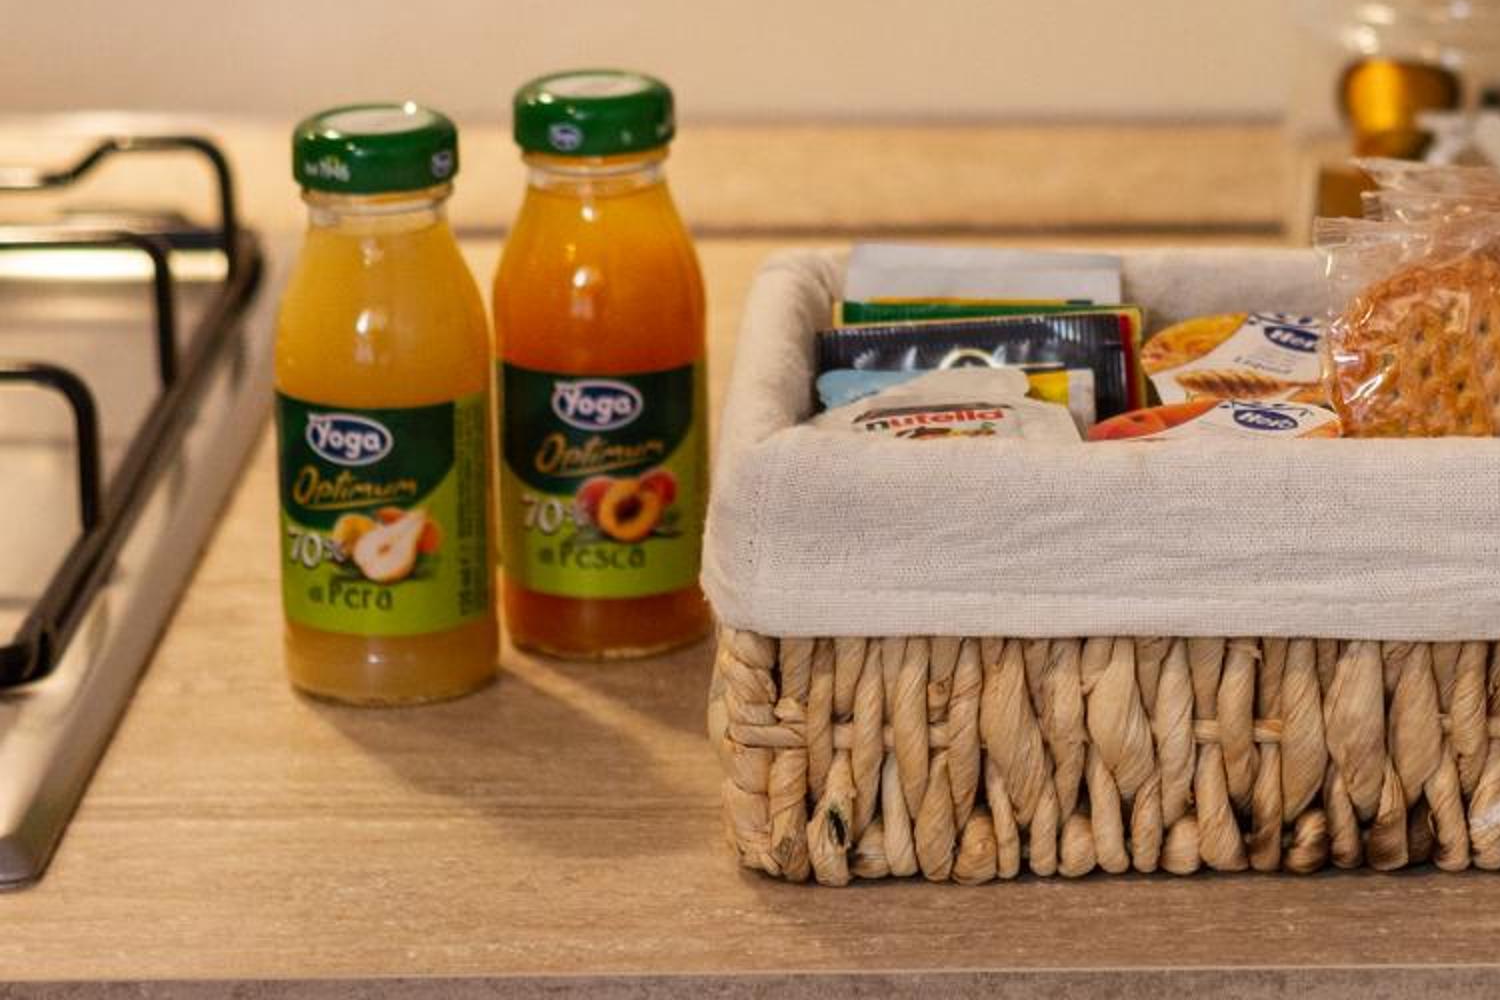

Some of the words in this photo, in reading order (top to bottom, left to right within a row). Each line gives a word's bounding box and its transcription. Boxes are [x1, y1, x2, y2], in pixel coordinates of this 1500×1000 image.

[1268, 328, 1316, 350] Her
[557, 384, 633, 425] Yoga
[866, 408, 1005, 432] nutella
[315, 418, 381, 459] Yoga
[535, 432, 664, 474] Optimum
[292, 466, 417, 506] Optimum
[560, 541, 646, 569] Pesca
[328, 580, 394, 610] Pera
